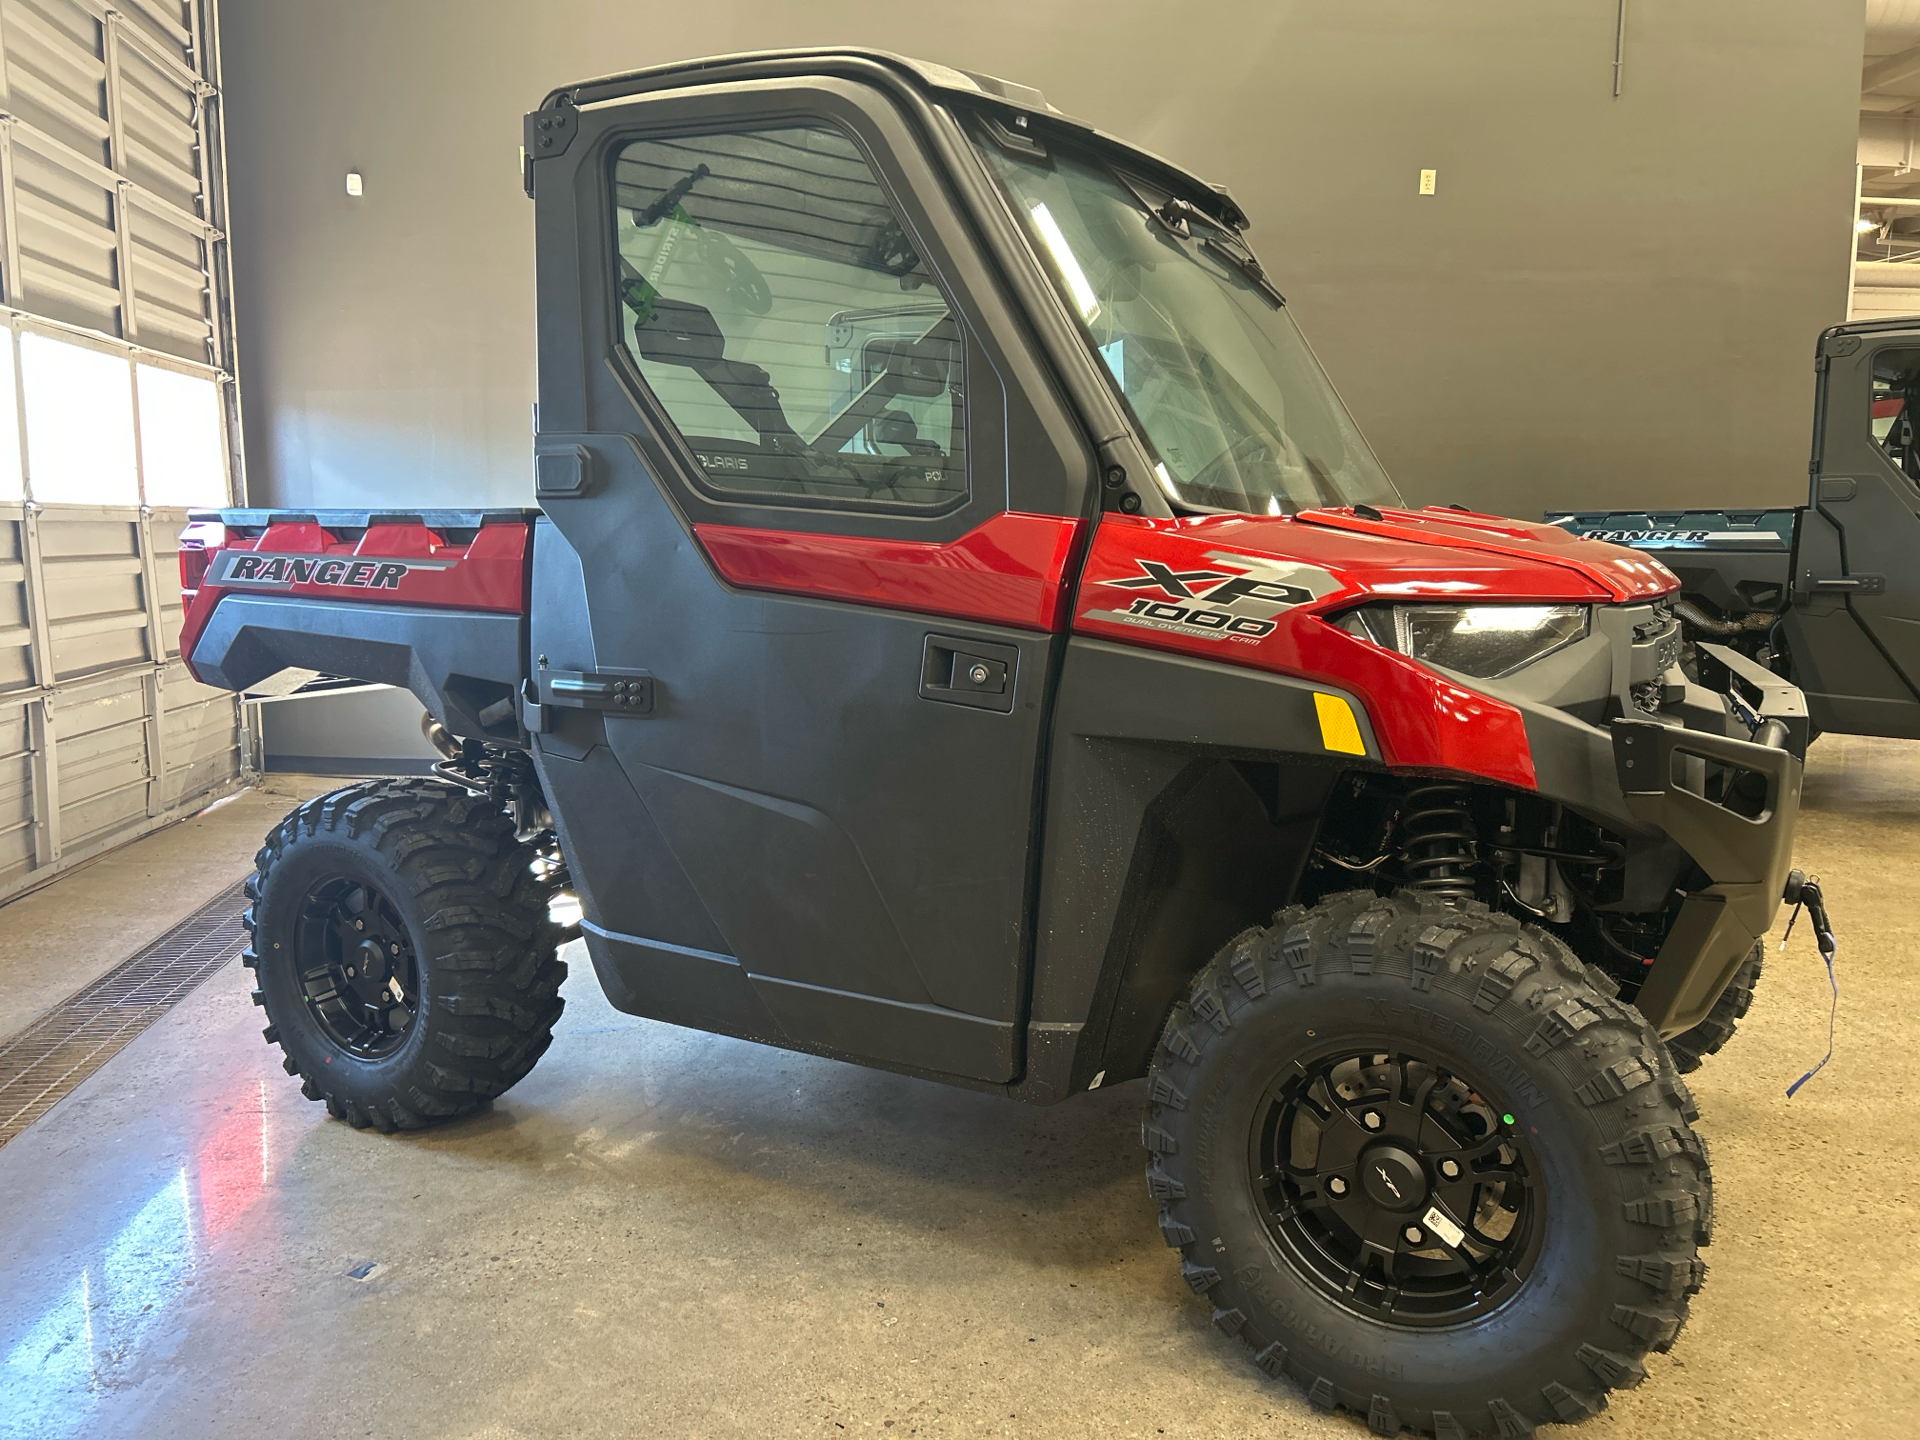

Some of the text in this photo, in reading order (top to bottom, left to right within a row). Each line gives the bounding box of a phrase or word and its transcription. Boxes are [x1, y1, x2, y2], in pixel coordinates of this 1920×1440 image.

[696, 454, 748, 470] OLARIS
[1587, 529, 1710, 542] RANGER
[229, 555, 409, 590] RANGER
[1093, 558, 1317, 607] XP
[1123, 616, 1262, 646] DUAL OVERHEAD CAM
[1129, 597, 1277, 638] 1000
[1365, 996, 1550, 1109] X-TERRAIN
[1256, 1284, 1344, 1357] ARMOR
